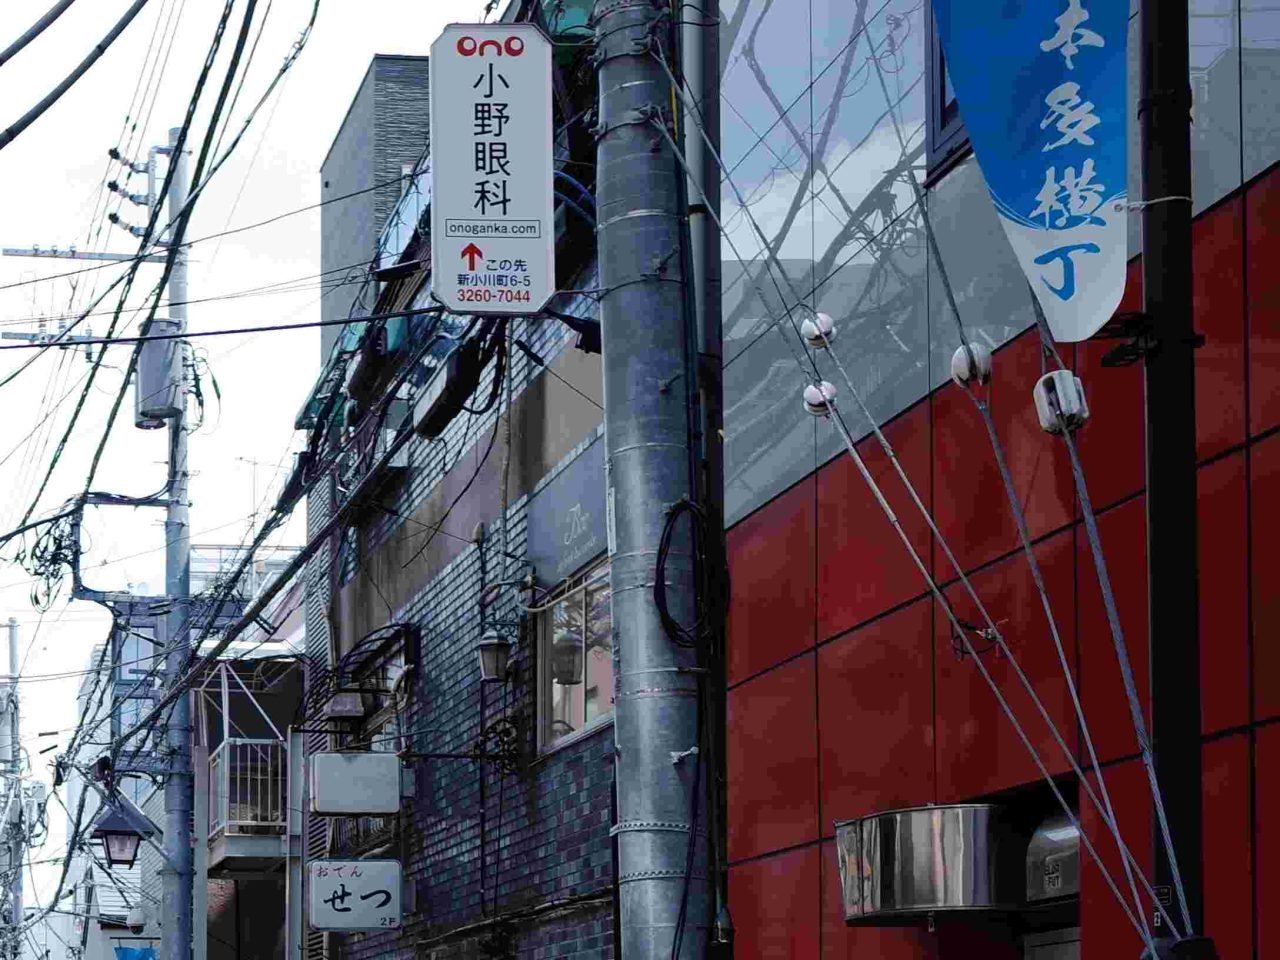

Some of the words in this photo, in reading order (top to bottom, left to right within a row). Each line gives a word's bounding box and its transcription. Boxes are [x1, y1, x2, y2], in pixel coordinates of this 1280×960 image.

[473, 63, 511, 216] 小野眼科
[1029, 0, 1107, 301] 本多横丁
[449, 222, 537, 235] onoganka.com
[486, 259, 528, 272] この先
[457, 274, 531, 287] 新小川町6-5
[457, 289, 531, 303] 3260-7044
[317, 865, 363, 878] おでん
[323, 883, 392, 912] せつ
[380, 917, 396, 926] 2F
